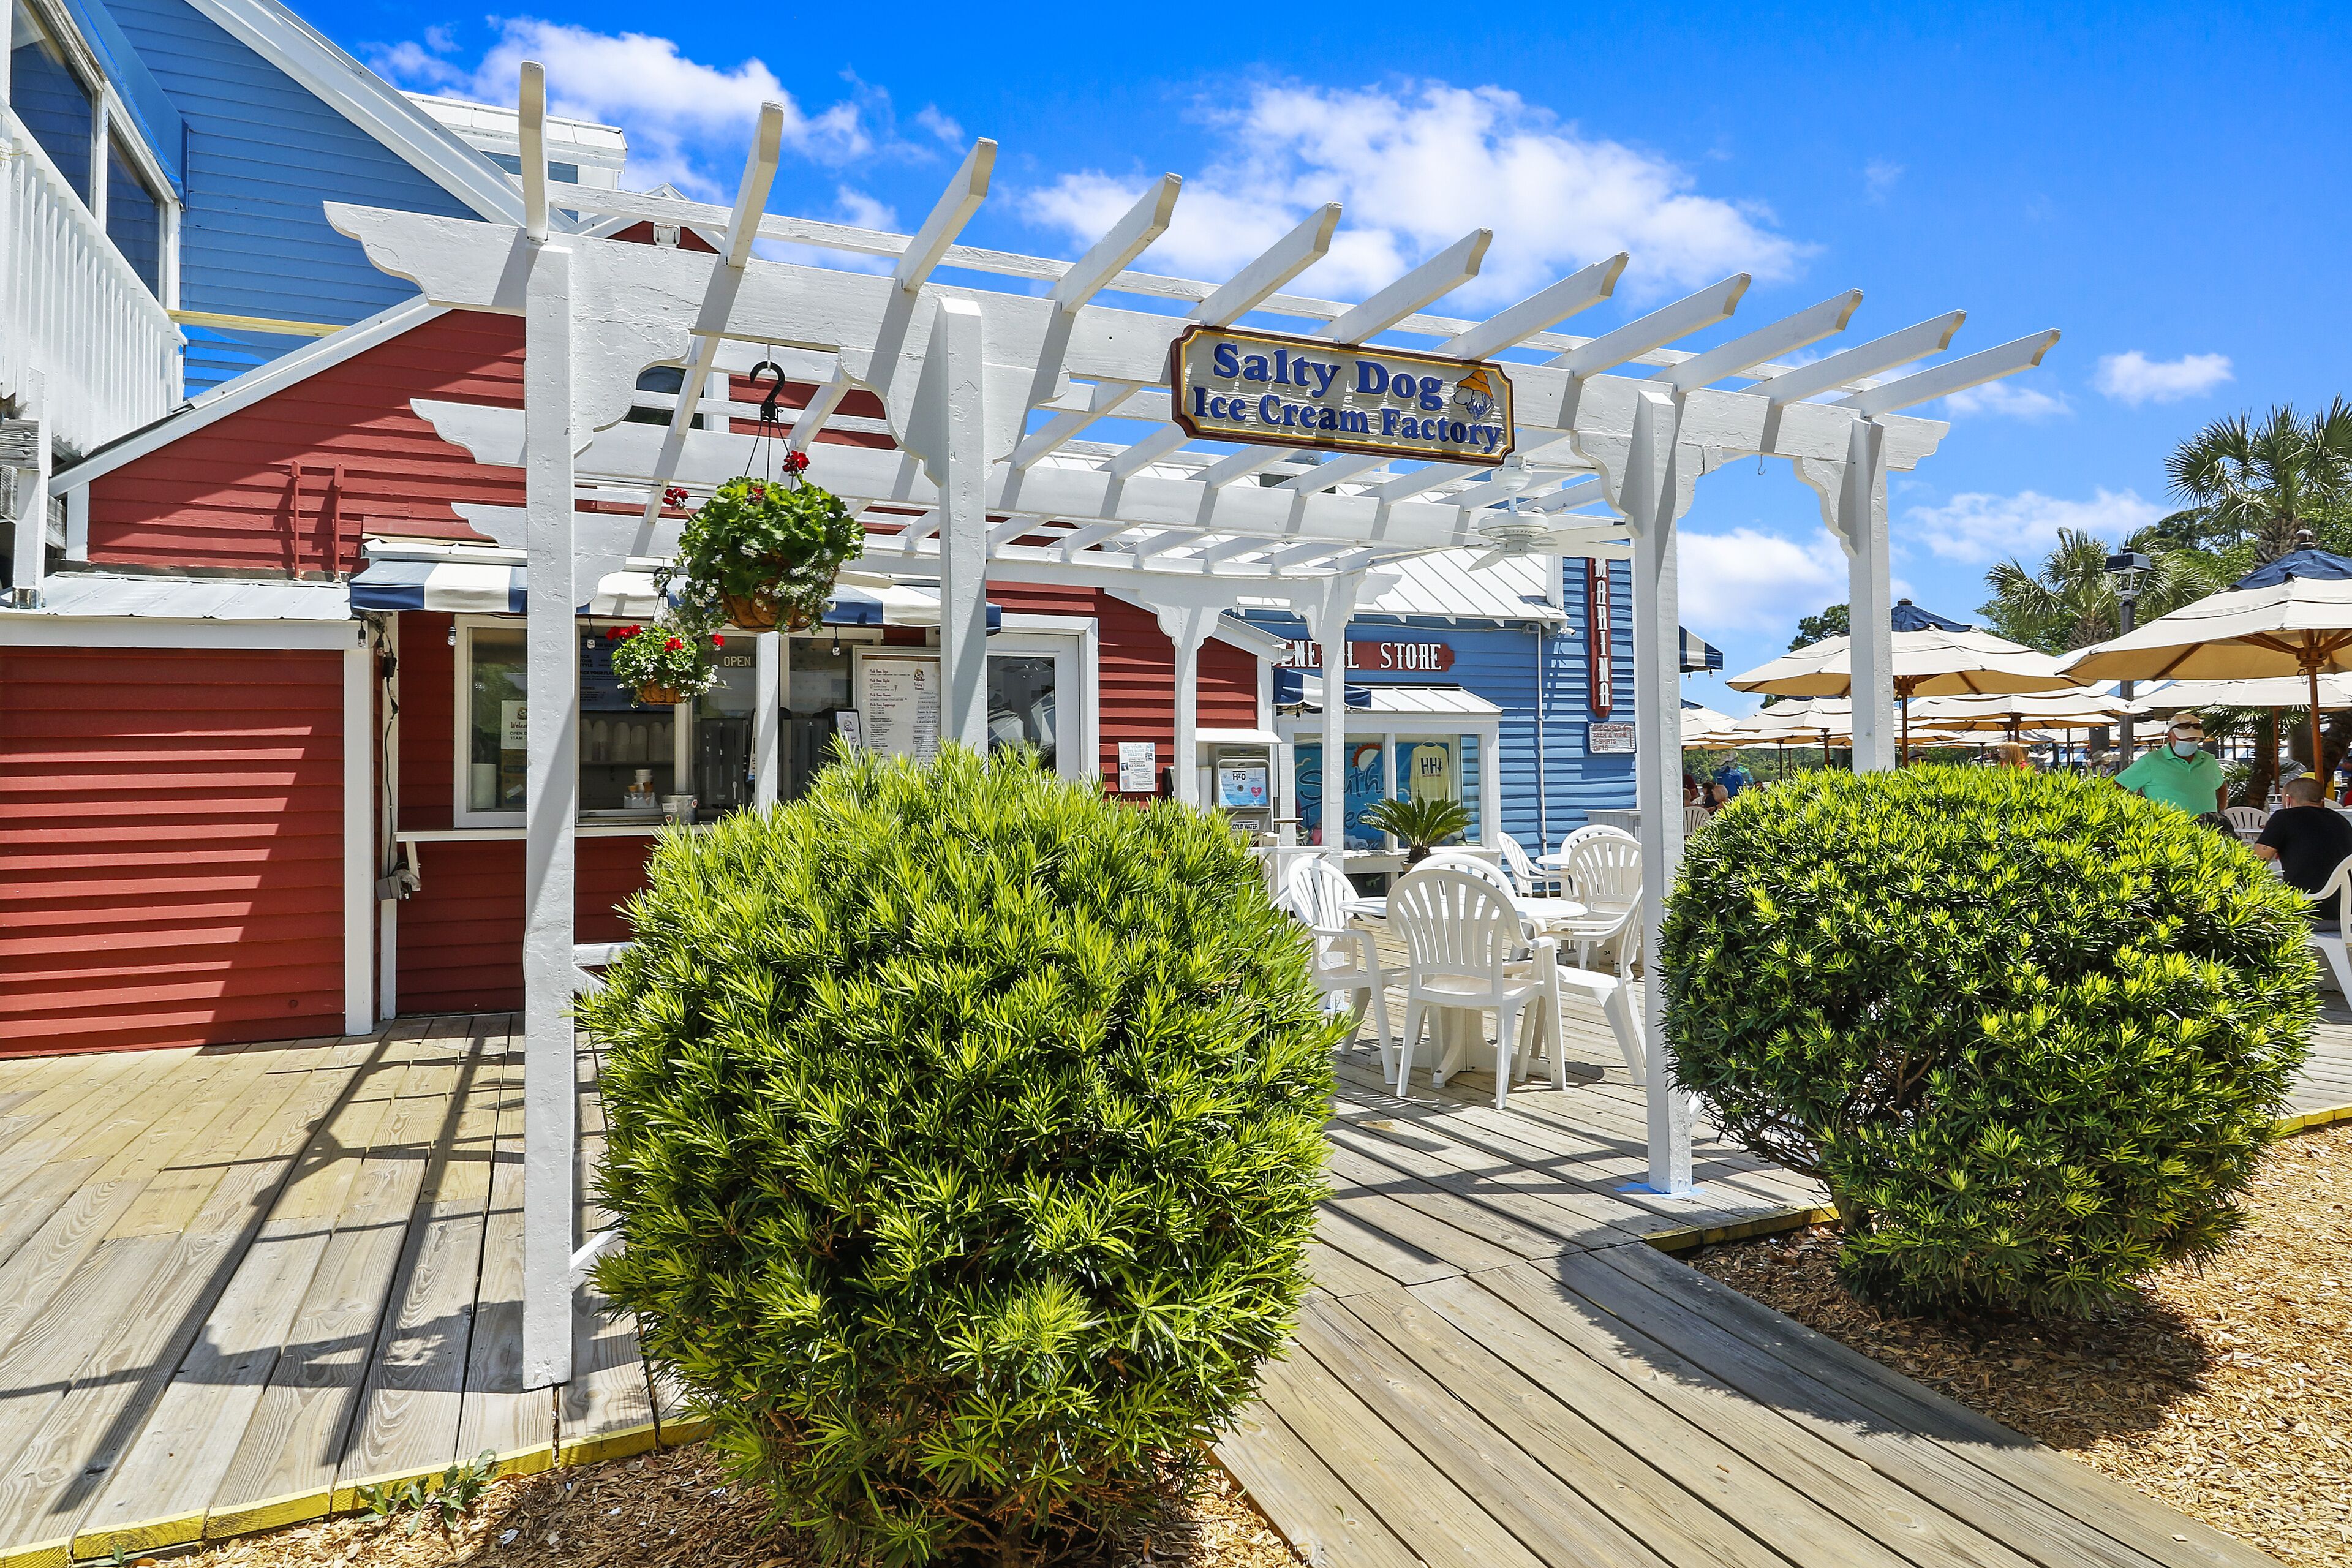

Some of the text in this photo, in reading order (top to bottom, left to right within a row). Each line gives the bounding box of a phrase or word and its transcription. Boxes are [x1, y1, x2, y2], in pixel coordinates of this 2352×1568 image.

[1213, 342, 1443, 412] Salty Dog
[1194, 386, 1501, 454] Ice Cream Factory
[723, 655, 752, 667] OPEN
[1380, 642, 1442, 670] STORE
[1594, 557, 1610, 707] MARINA
